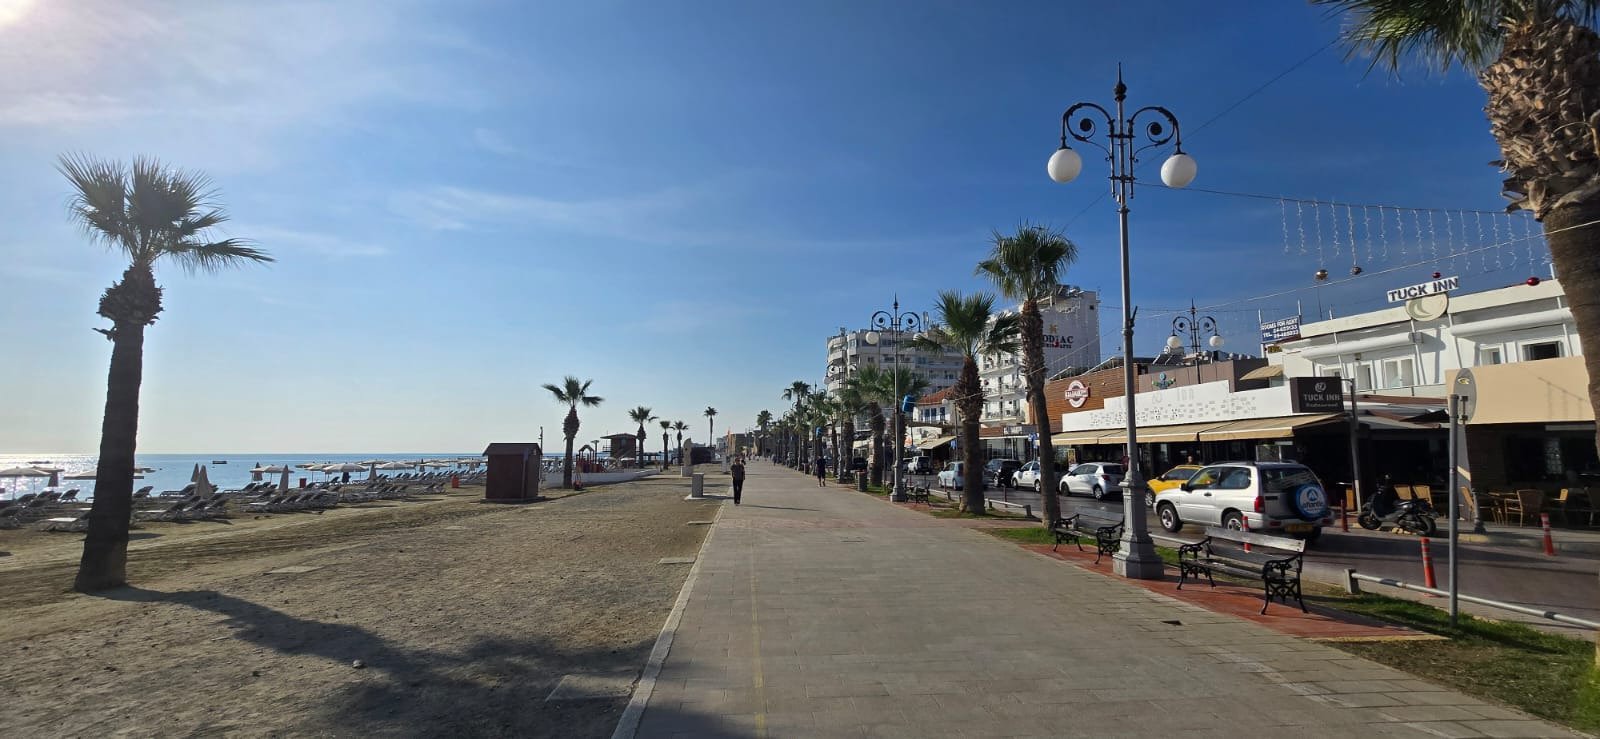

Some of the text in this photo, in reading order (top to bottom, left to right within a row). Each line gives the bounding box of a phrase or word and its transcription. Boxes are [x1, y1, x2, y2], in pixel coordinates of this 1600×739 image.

[1389, 278, 1458, 301] TUCK INN
[1042, 335, 1073, 344] ODIAC
[1303, 393, 1340, 401] TUCK INN
